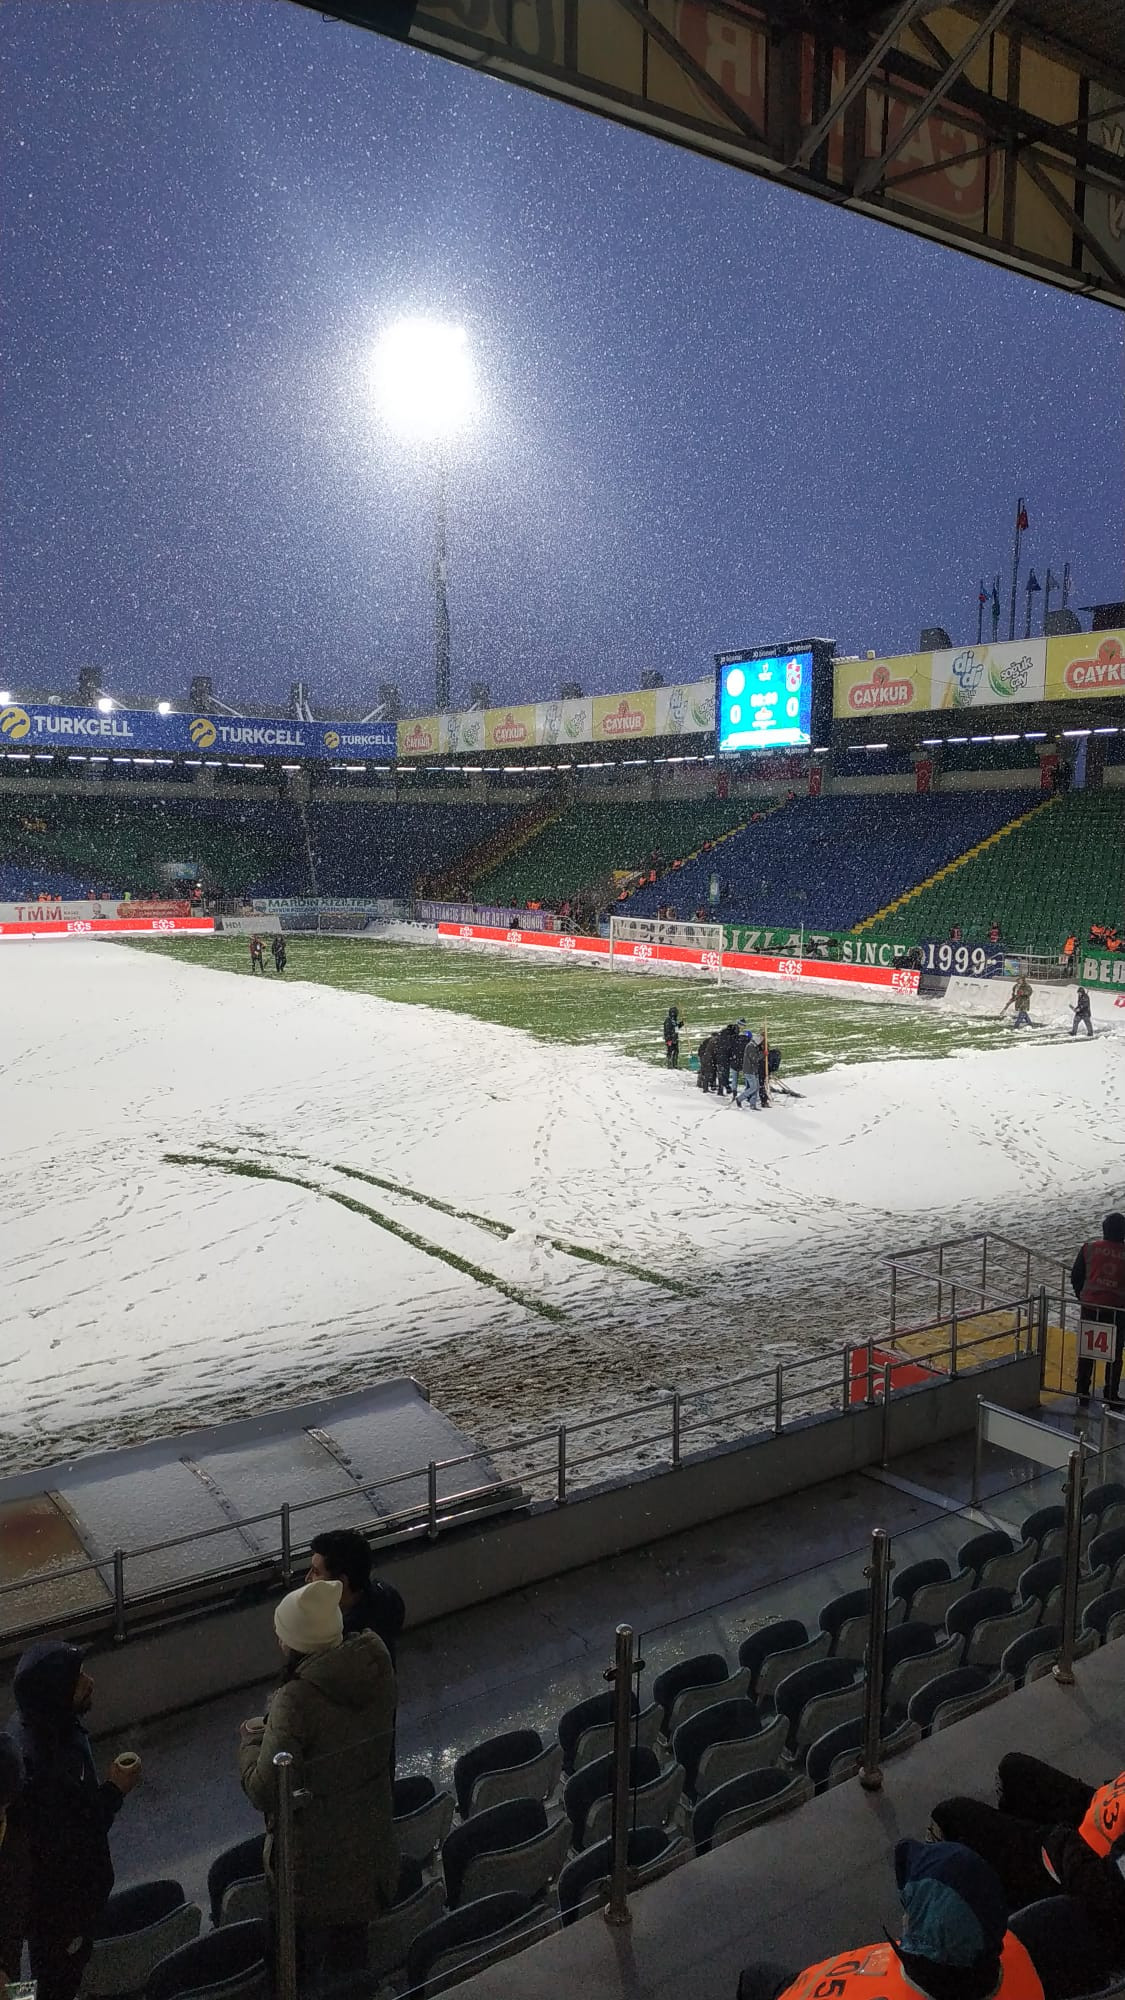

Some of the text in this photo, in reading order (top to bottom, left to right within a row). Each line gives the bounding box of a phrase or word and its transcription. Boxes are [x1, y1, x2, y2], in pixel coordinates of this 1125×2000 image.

[34, 715, 134, 737] TURKCELL
[219, 726, 305, 746] TURKCELL
[341, 735, 394, 745] TURKCELL
[1084, 1330, 1109, 1353] 14
